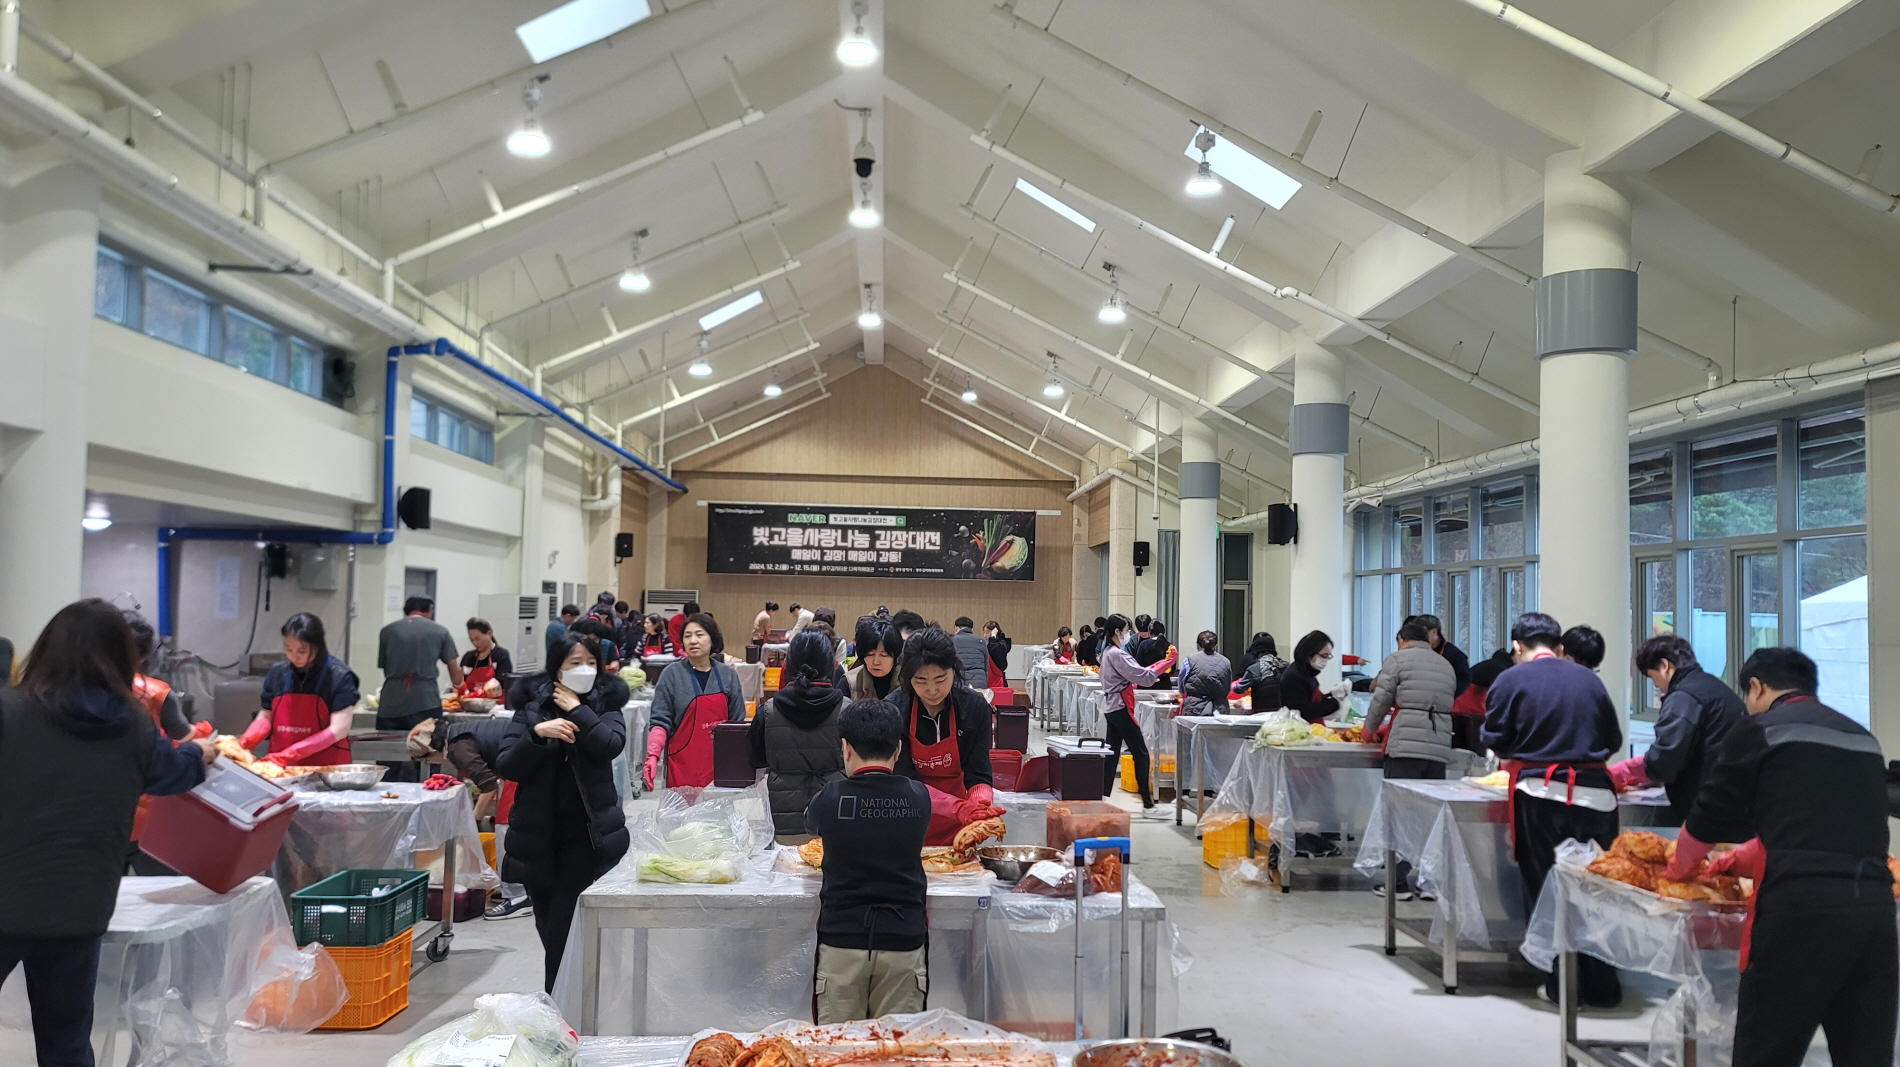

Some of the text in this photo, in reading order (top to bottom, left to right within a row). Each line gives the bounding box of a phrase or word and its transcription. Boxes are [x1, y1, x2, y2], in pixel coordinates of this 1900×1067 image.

[788, 513, 826, 523] NAVER
[752, 526, 941, 550] 빛고을사랑나눔 김장대전
[791, 549, 902, 563] 매일이 김장! 매일이 감동!
[860, 798, 910, 808] NATIONAL
[859, 808, 922, 819] GEOGRAPHIC
